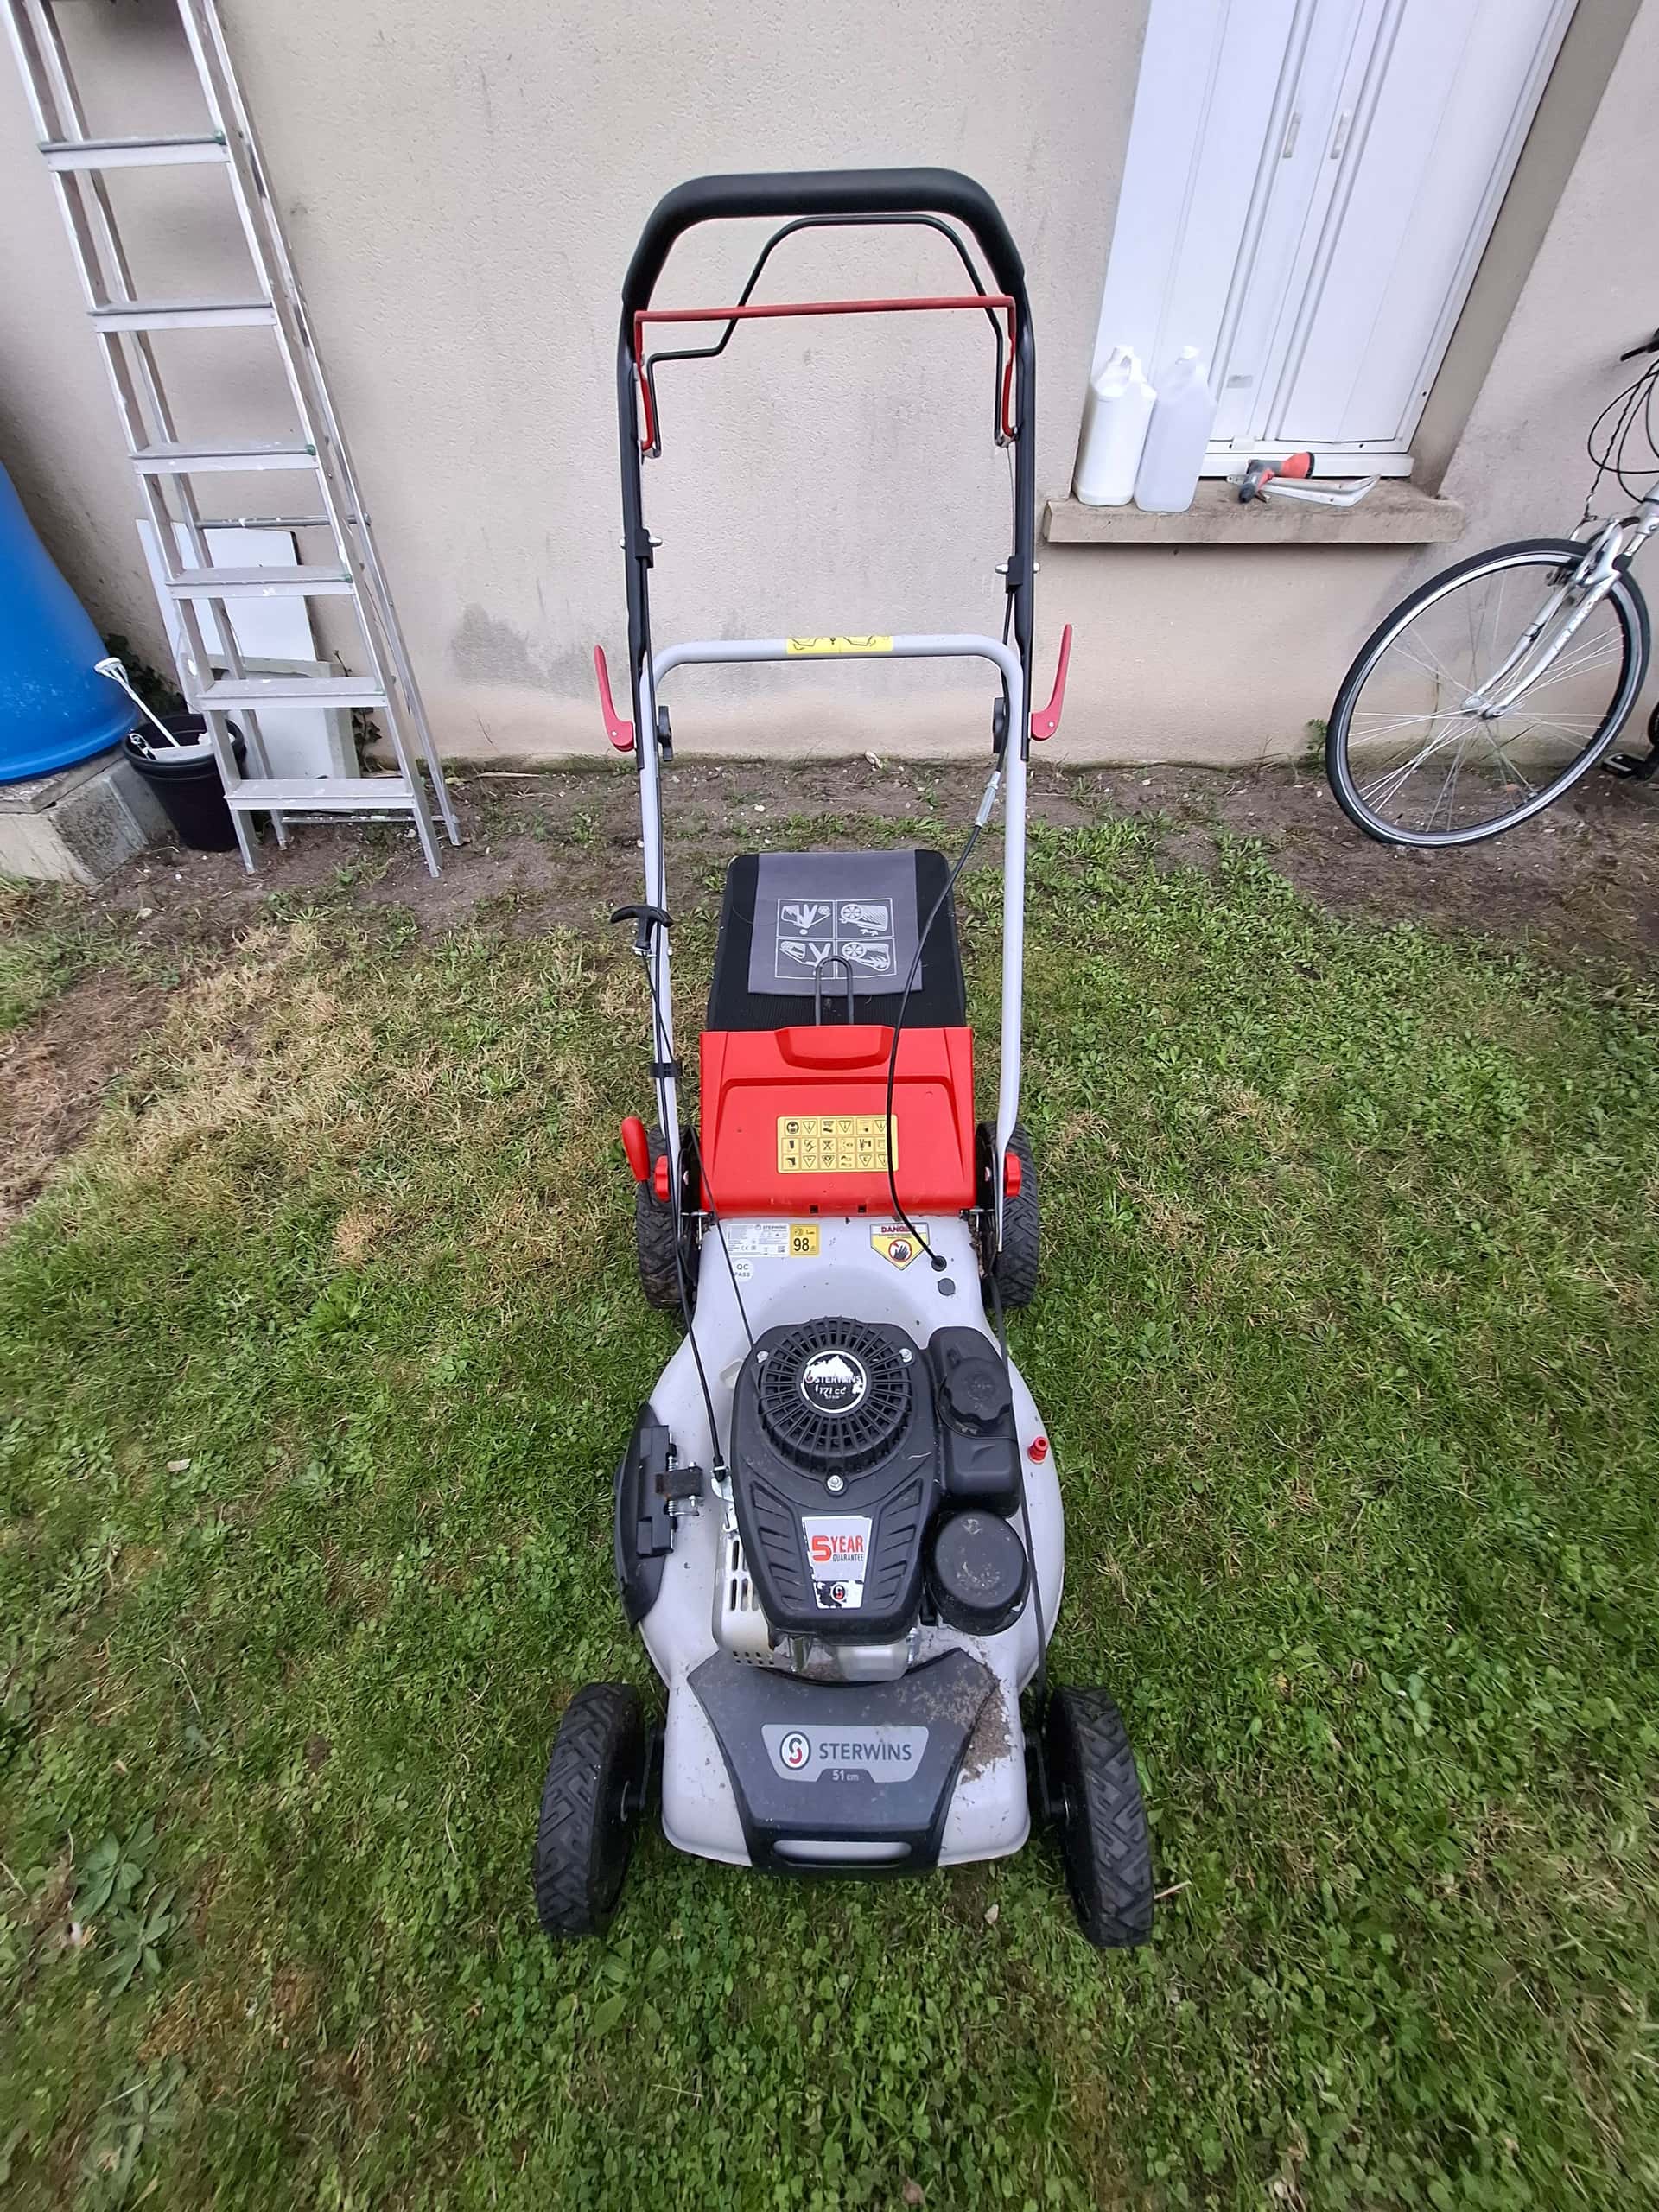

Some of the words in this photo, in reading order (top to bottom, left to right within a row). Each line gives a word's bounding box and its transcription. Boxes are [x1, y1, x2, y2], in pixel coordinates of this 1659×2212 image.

[793, 1237, 810, 1252] 98
[812, 1535, 832, 1561] 5
[831, 1535, 864, 1553] YEAR
[833, 1554, 864, 1562] GUARANTEE
[819, 1742, 912, 1761] STERWINS
[832, 1770, 845, 1781] 51
